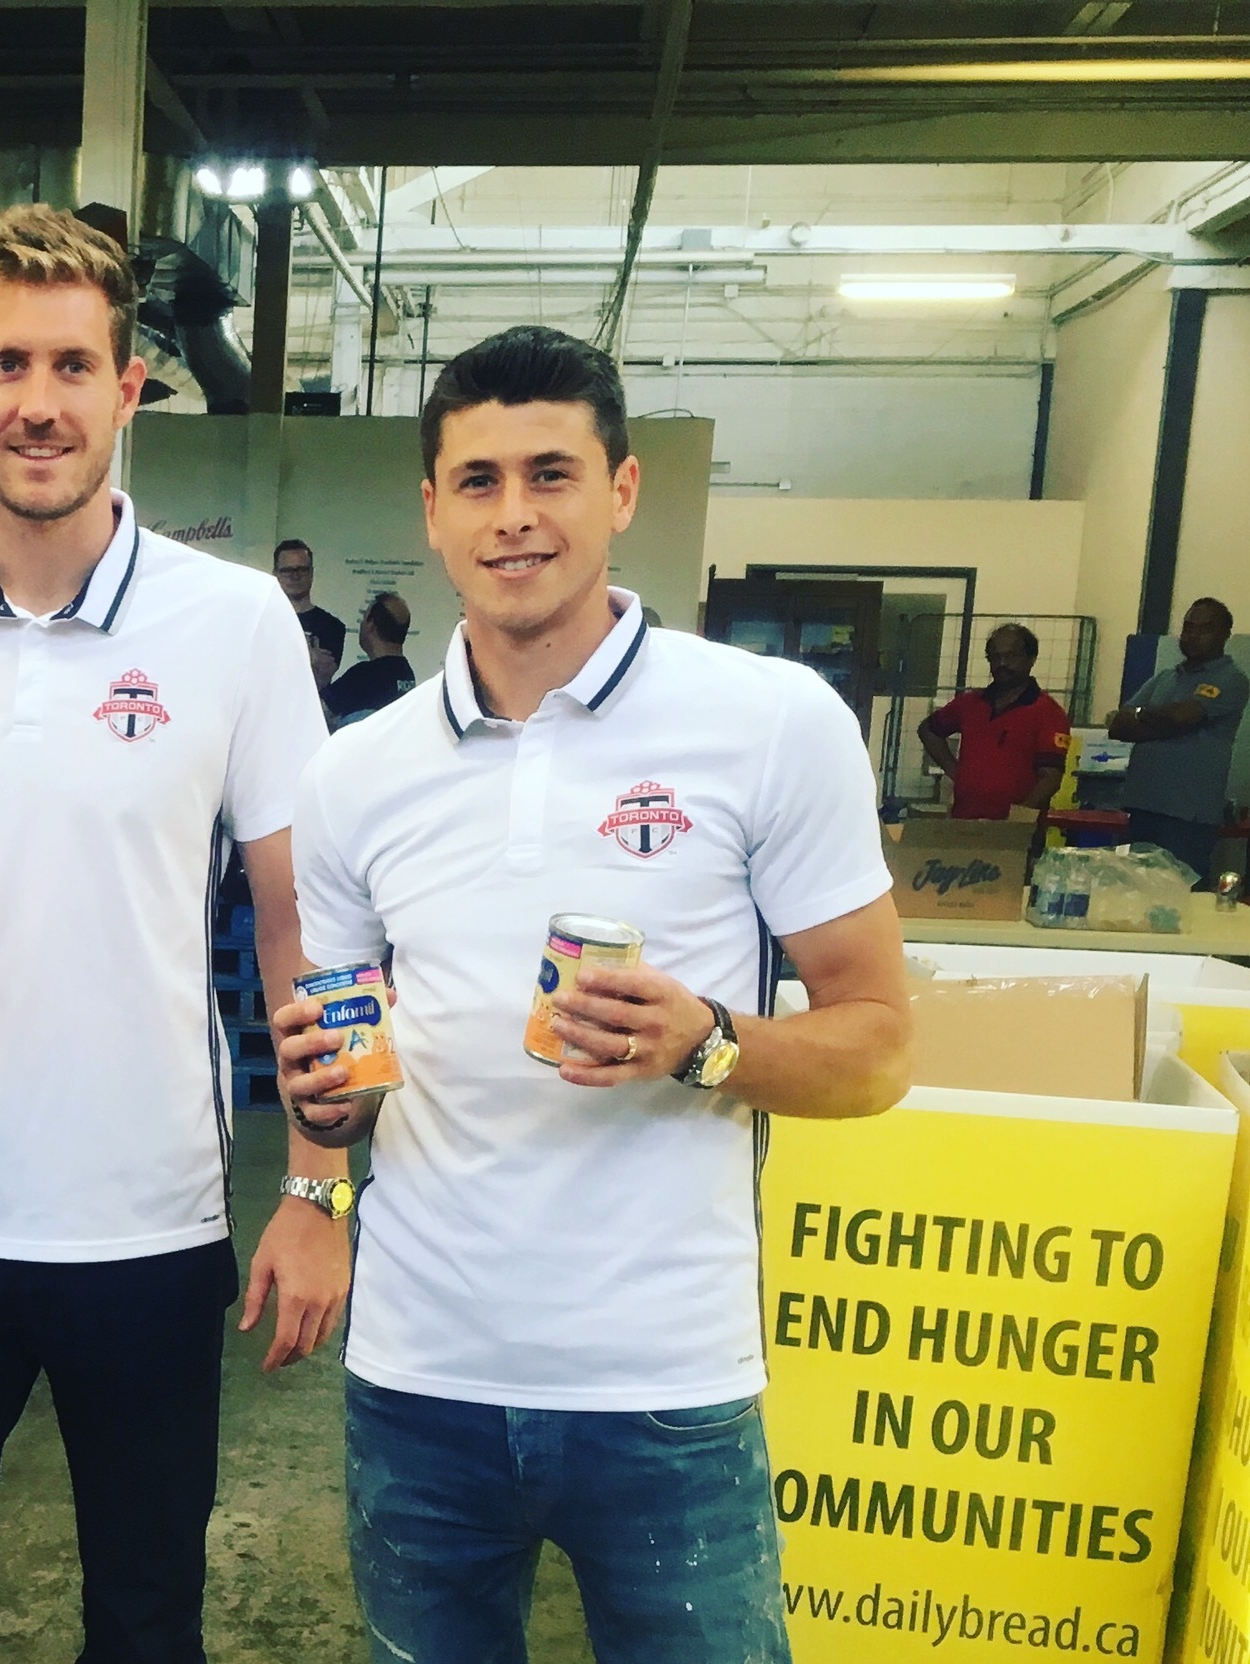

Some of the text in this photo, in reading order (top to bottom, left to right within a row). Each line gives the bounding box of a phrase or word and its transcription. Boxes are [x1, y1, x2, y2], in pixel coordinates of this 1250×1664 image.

[104, 702, 161, 714] TORONTO
[610, 810, 679, 824] TORONTO
[323, 1000, 375, 1024] Enfamil
[791, 1202, 1164, 1290] FIGHTING TO
[775, 1291, 1159, 1383] END HUNGER
[852, 1389, 1056, 1465] IN OUR
[775, 1469, 1154, 1564] OMMUNITIES
